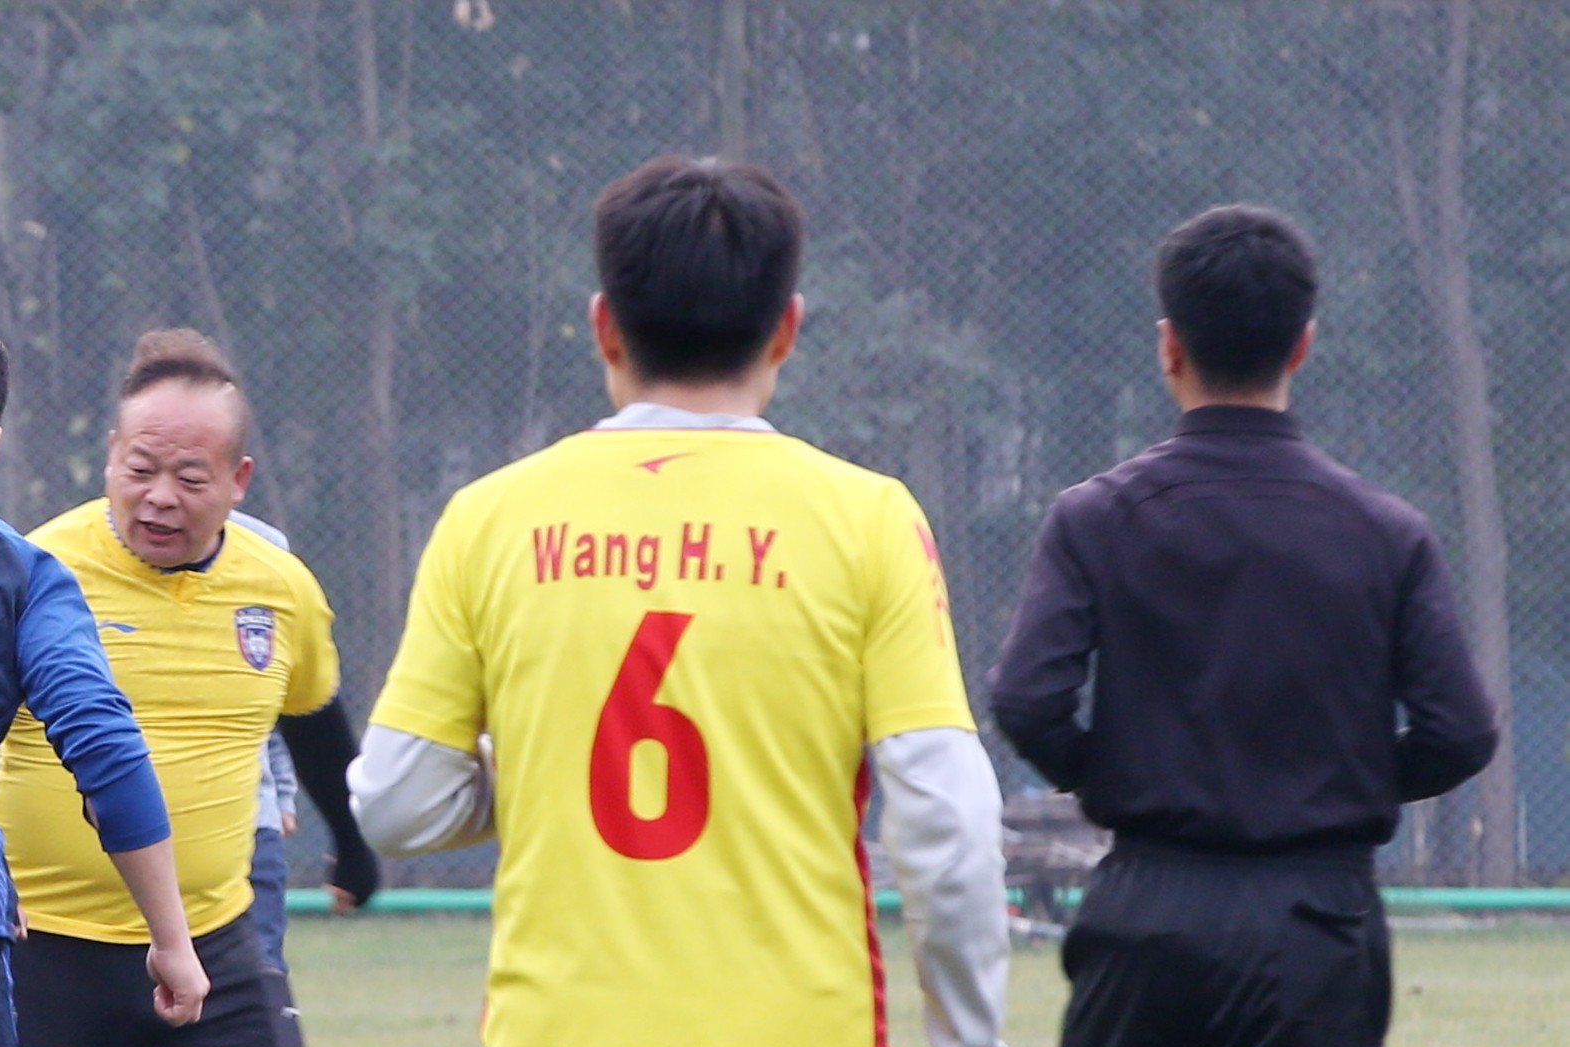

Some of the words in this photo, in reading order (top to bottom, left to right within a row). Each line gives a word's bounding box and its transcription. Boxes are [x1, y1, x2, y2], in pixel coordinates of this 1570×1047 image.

[533, 521, 660, 591] Wang
[678, 521, 725, 581] H.
[746, 526, 787, 590] Y.
[589, 610, 710, 862] 6
